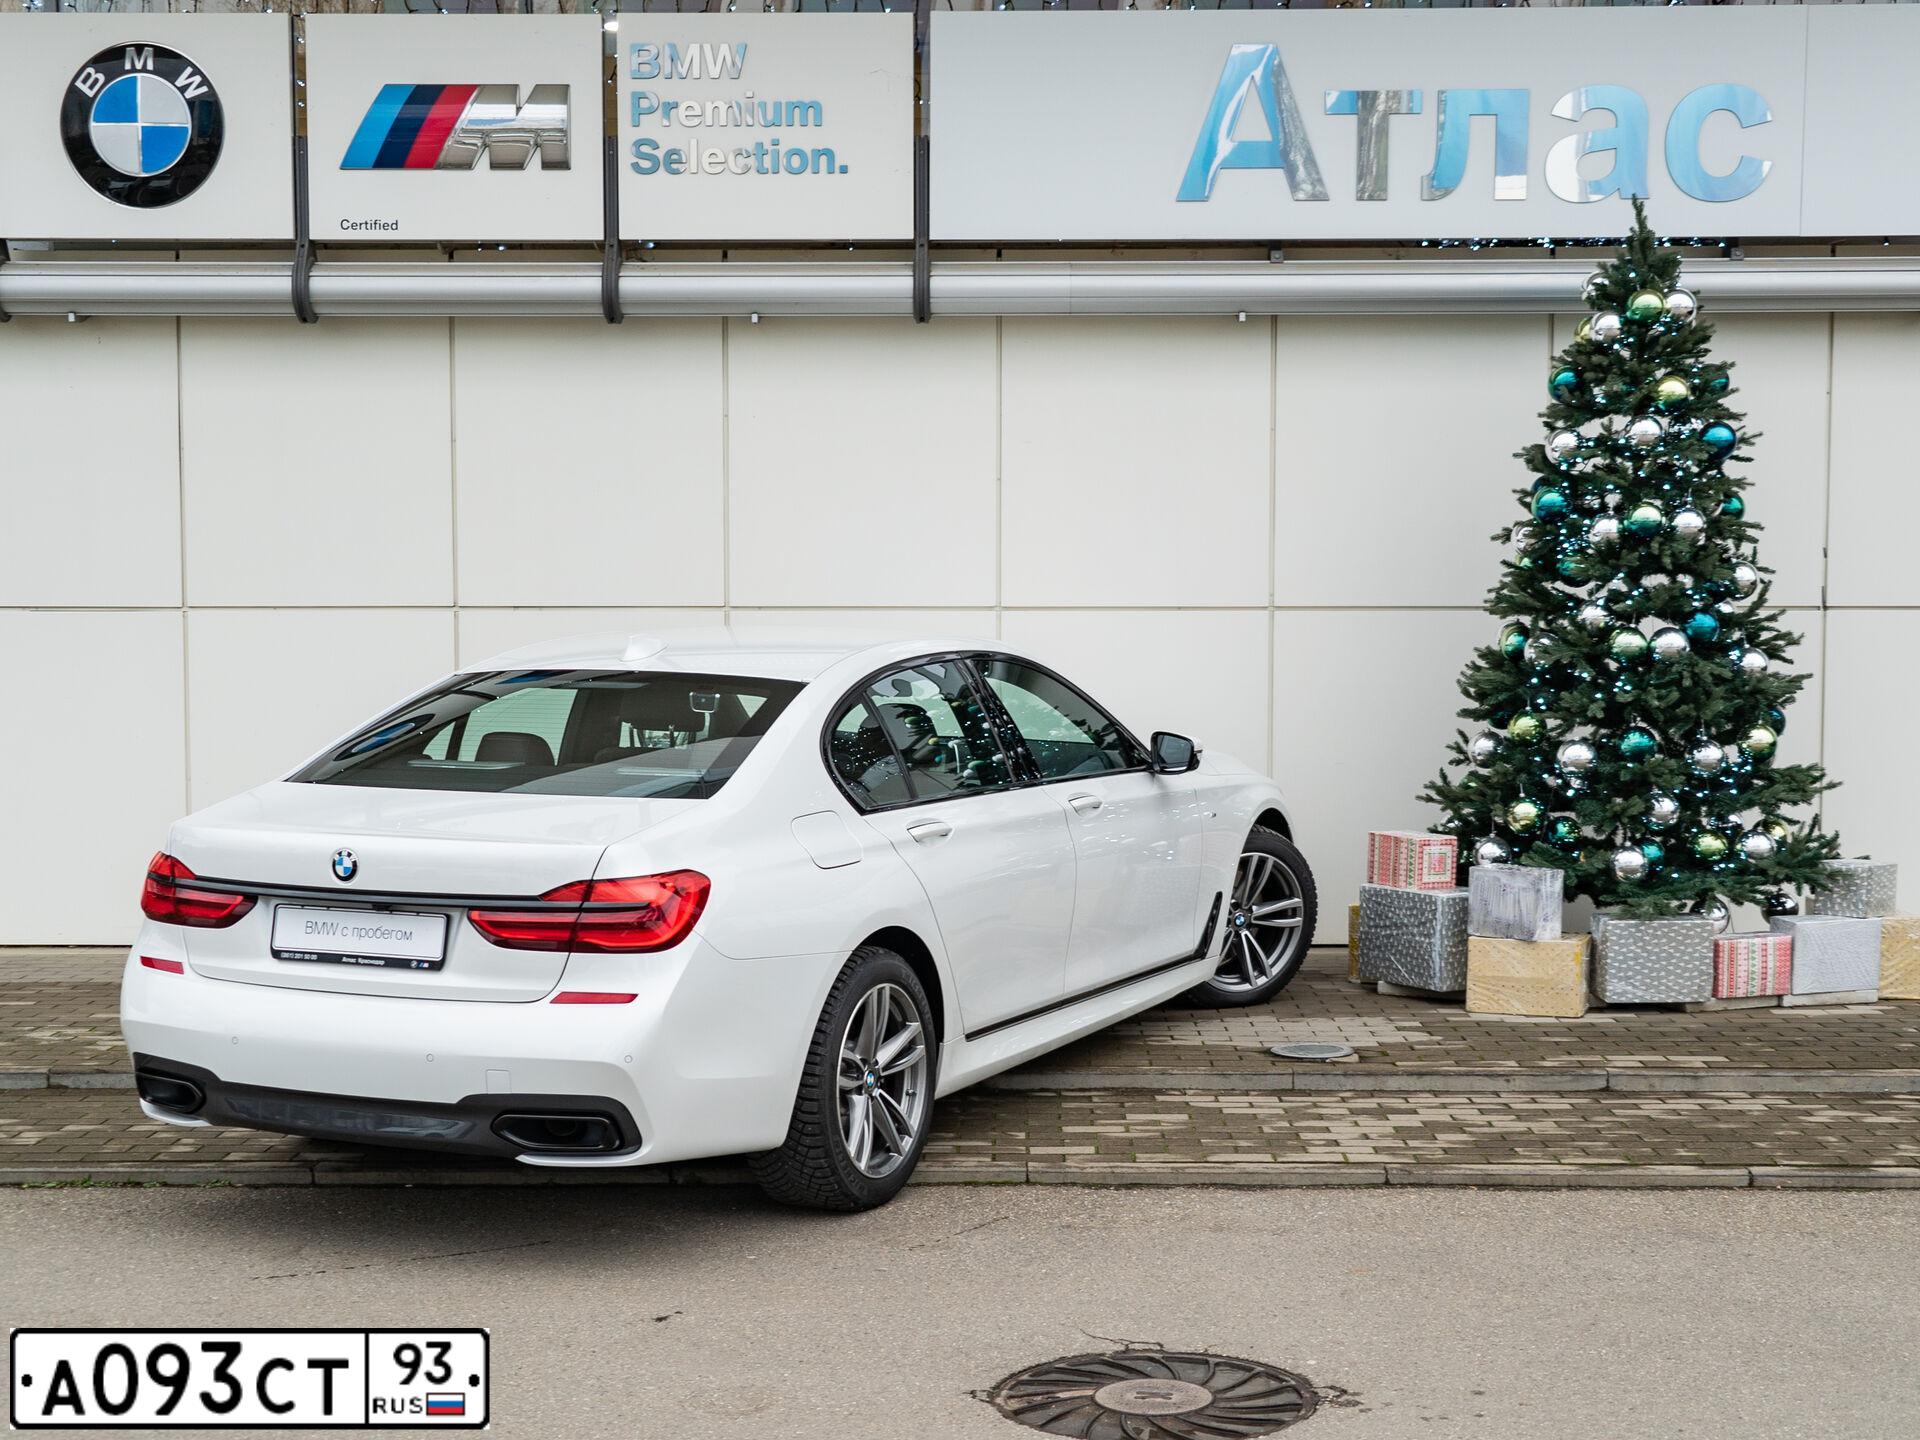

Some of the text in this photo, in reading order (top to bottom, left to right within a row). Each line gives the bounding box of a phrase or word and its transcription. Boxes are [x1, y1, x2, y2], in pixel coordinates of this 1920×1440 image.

[75, 46, 208, 99] BMW
[629, 42, 747, 80] BMW
[629, 90, 823, 128] Premium
[1176, 42, 1774, 204] Атлас
[629, 137, 849, 175] Selection.
[339, 218, 399, 231] Certified
[304, 920, 339, 936] BMW
[352, 924, 413, 941] пробегом
